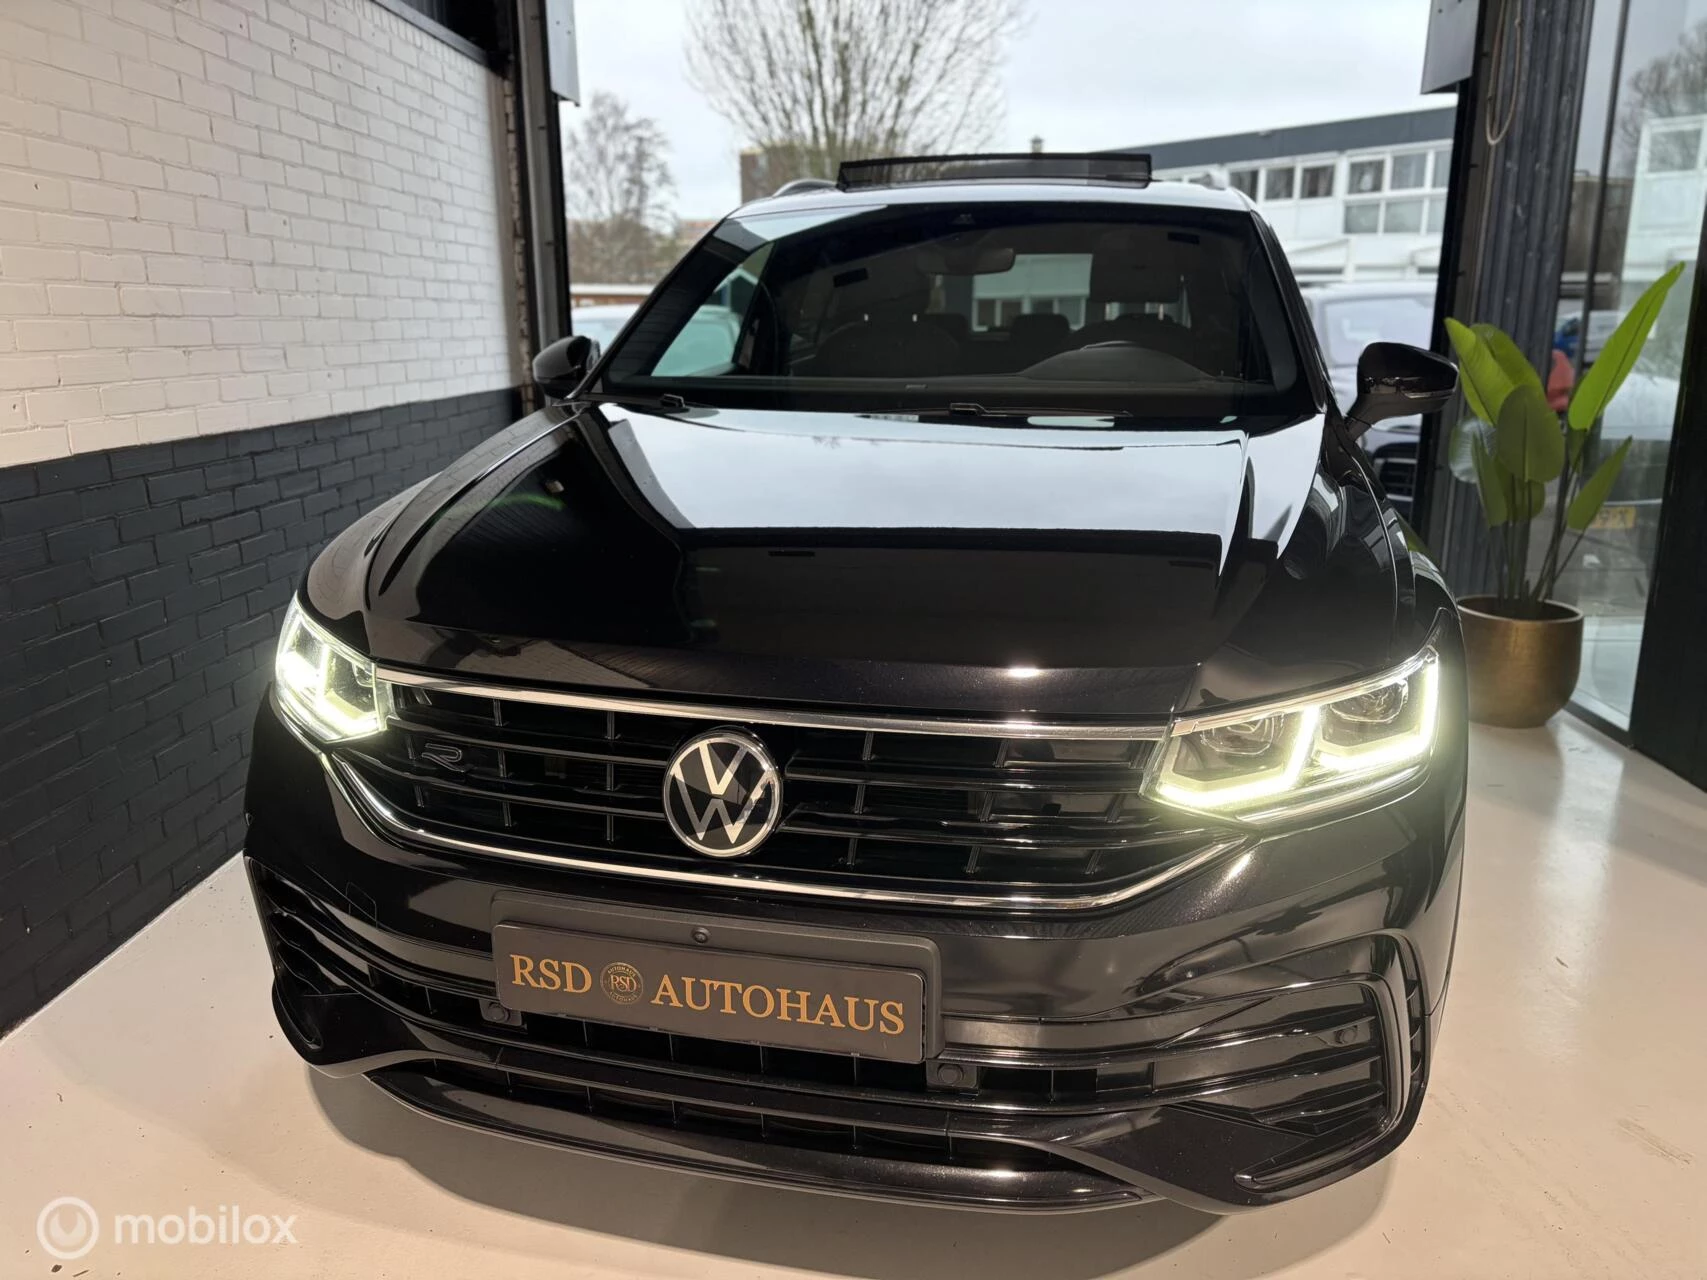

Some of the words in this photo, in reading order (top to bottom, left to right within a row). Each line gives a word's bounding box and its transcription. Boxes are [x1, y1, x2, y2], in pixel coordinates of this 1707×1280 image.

[510, 954, 592, 993] RSD
[650, 974, 904, 1034] AUTOHAUS
[610, 974, 637, 992] RSD
